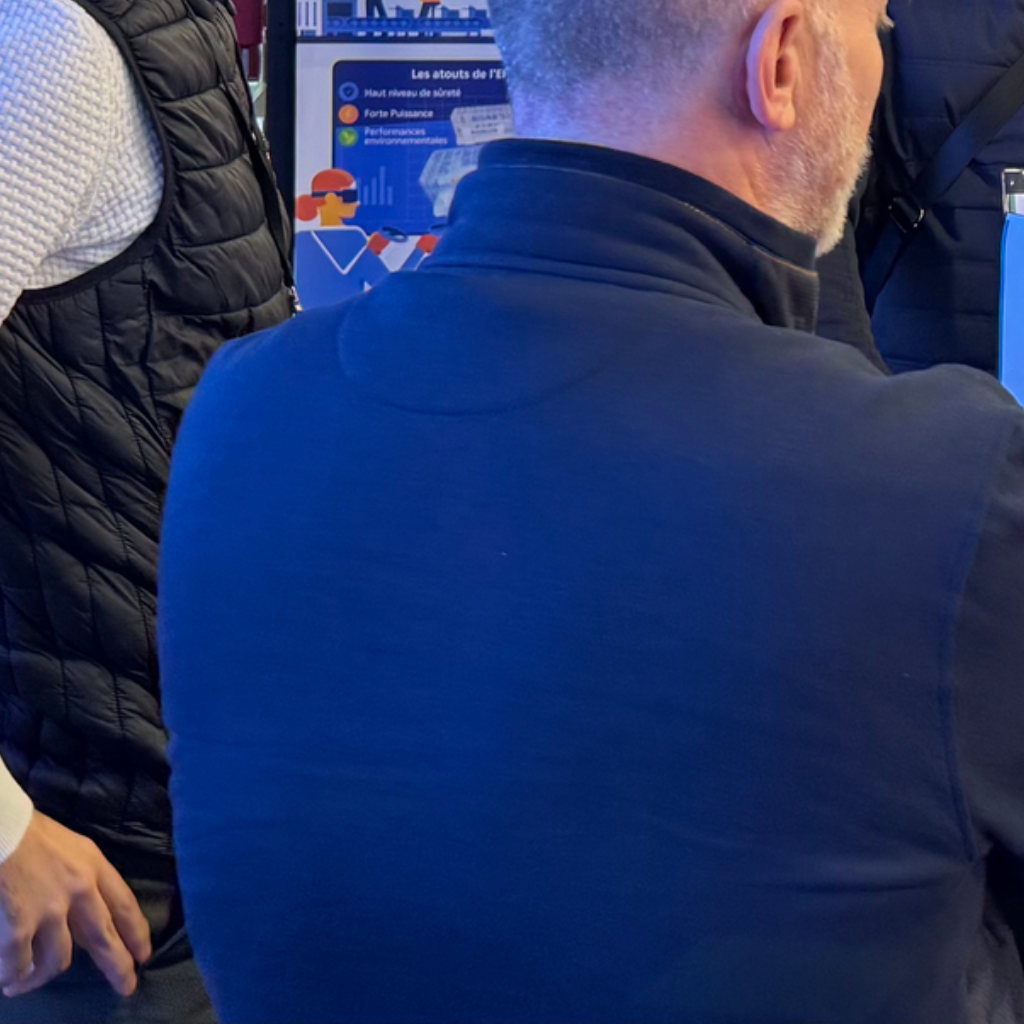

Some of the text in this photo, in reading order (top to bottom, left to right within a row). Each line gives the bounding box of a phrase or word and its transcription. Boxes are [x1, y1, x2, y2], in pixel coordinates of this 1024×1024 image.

[411, 68, 430, 80] Les
[432, 68, 469, 80] atouts
[472, 68, 487, 80] de
[364, 88, 386, 98] Haut
[388, 89, 417, 98] niveau
[419, 88, 431, 98] de
[364, 108, 434, 118] Forte Puissance
